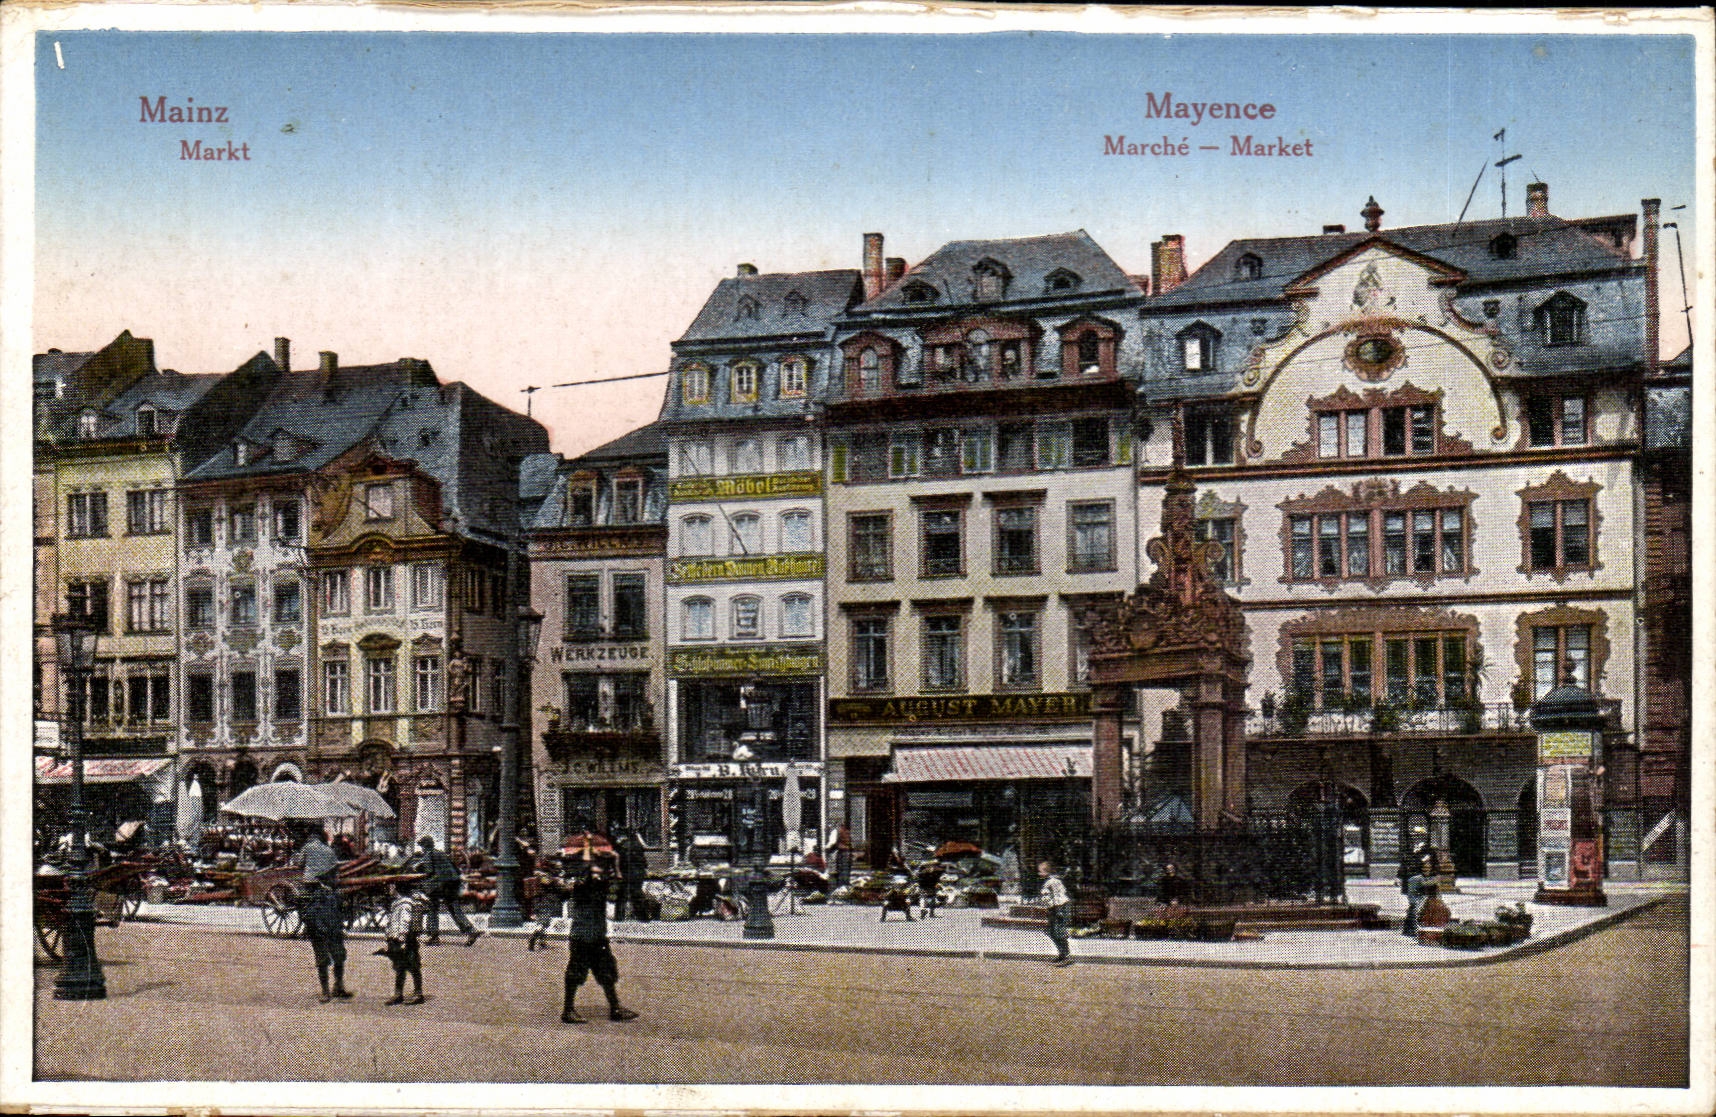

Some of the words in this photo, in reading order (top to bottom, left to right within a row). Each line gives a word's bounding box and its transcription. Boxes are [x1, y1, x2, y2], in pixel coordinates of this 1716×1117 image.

[715, 476, 771, 495] Möbel
[881, 698, 977, 717] AUGUST
[989, 696, 1076, 714] MAYER
